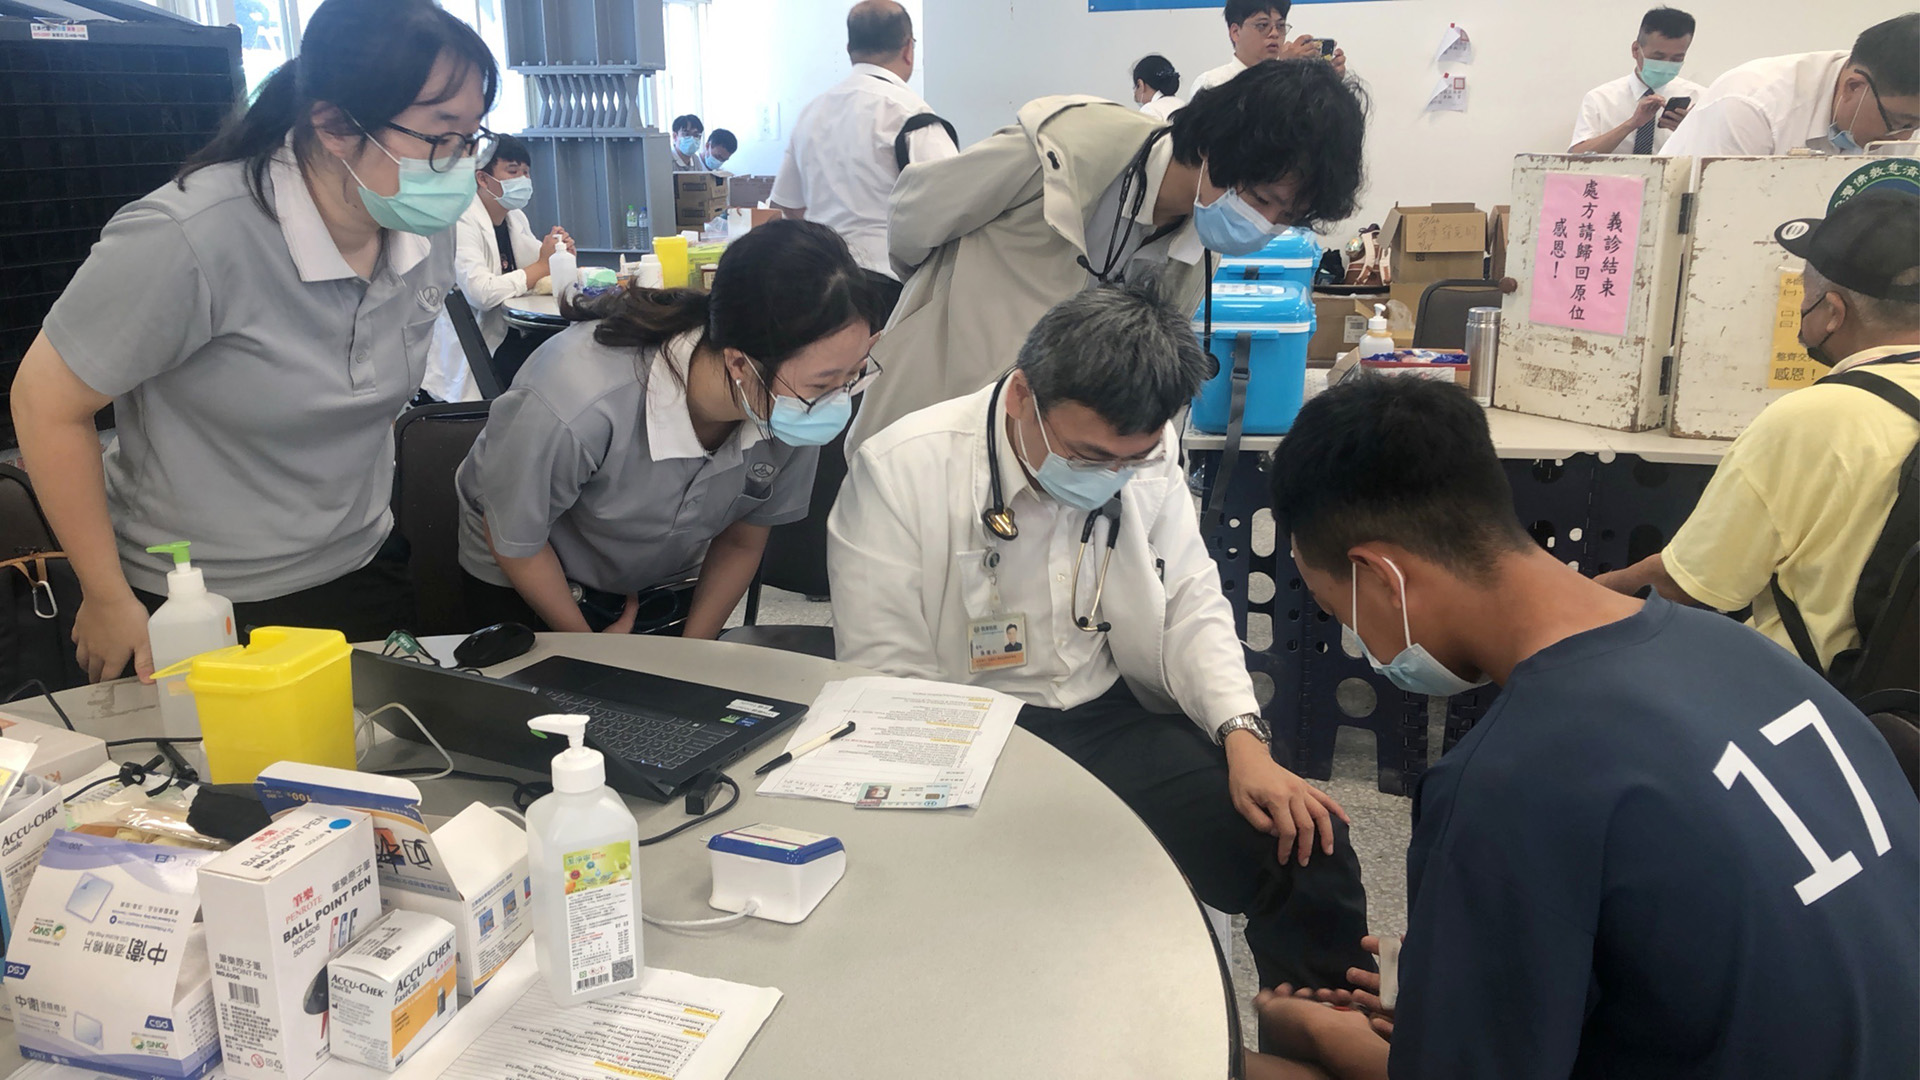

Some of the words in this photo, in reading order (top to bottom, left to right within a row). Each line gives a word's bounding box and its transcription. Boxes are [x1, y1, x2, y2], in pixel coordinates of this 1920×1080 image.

[1569, 179, 1599, 321] 處方請歸回原位
[1598, 211, 1623, 298] 義診結束
[1713, 699, 1892, 906] 17
[1, 805, 58, 849] ACCU-CHEK
[241, 850, 273, 867] BALL
[270, 829, 304, 851] POINT
[303, 815, 328, 830] PEN
[2, 841, 22, 857] Guide
[283, 918, 311, 943] BALL
[315, 893, 348, 926] POINT
[351, 876, 371, 900] PEN
[285, 895, 323, 924] PENROTE
[292, 924, 321, 948] NO.6506
[292, 938, 316, 958] 50PCS
[215, 962, 232, 973] BALL
[232, 966, 252, 977] POINT
[253, 971, 267, 980] PEN
[394, 938, 452, 997] ACCU-CHEK
[331, 974, 385, 998] ACCU-CHEK
[394, 981, 420, 1005] FastClix
